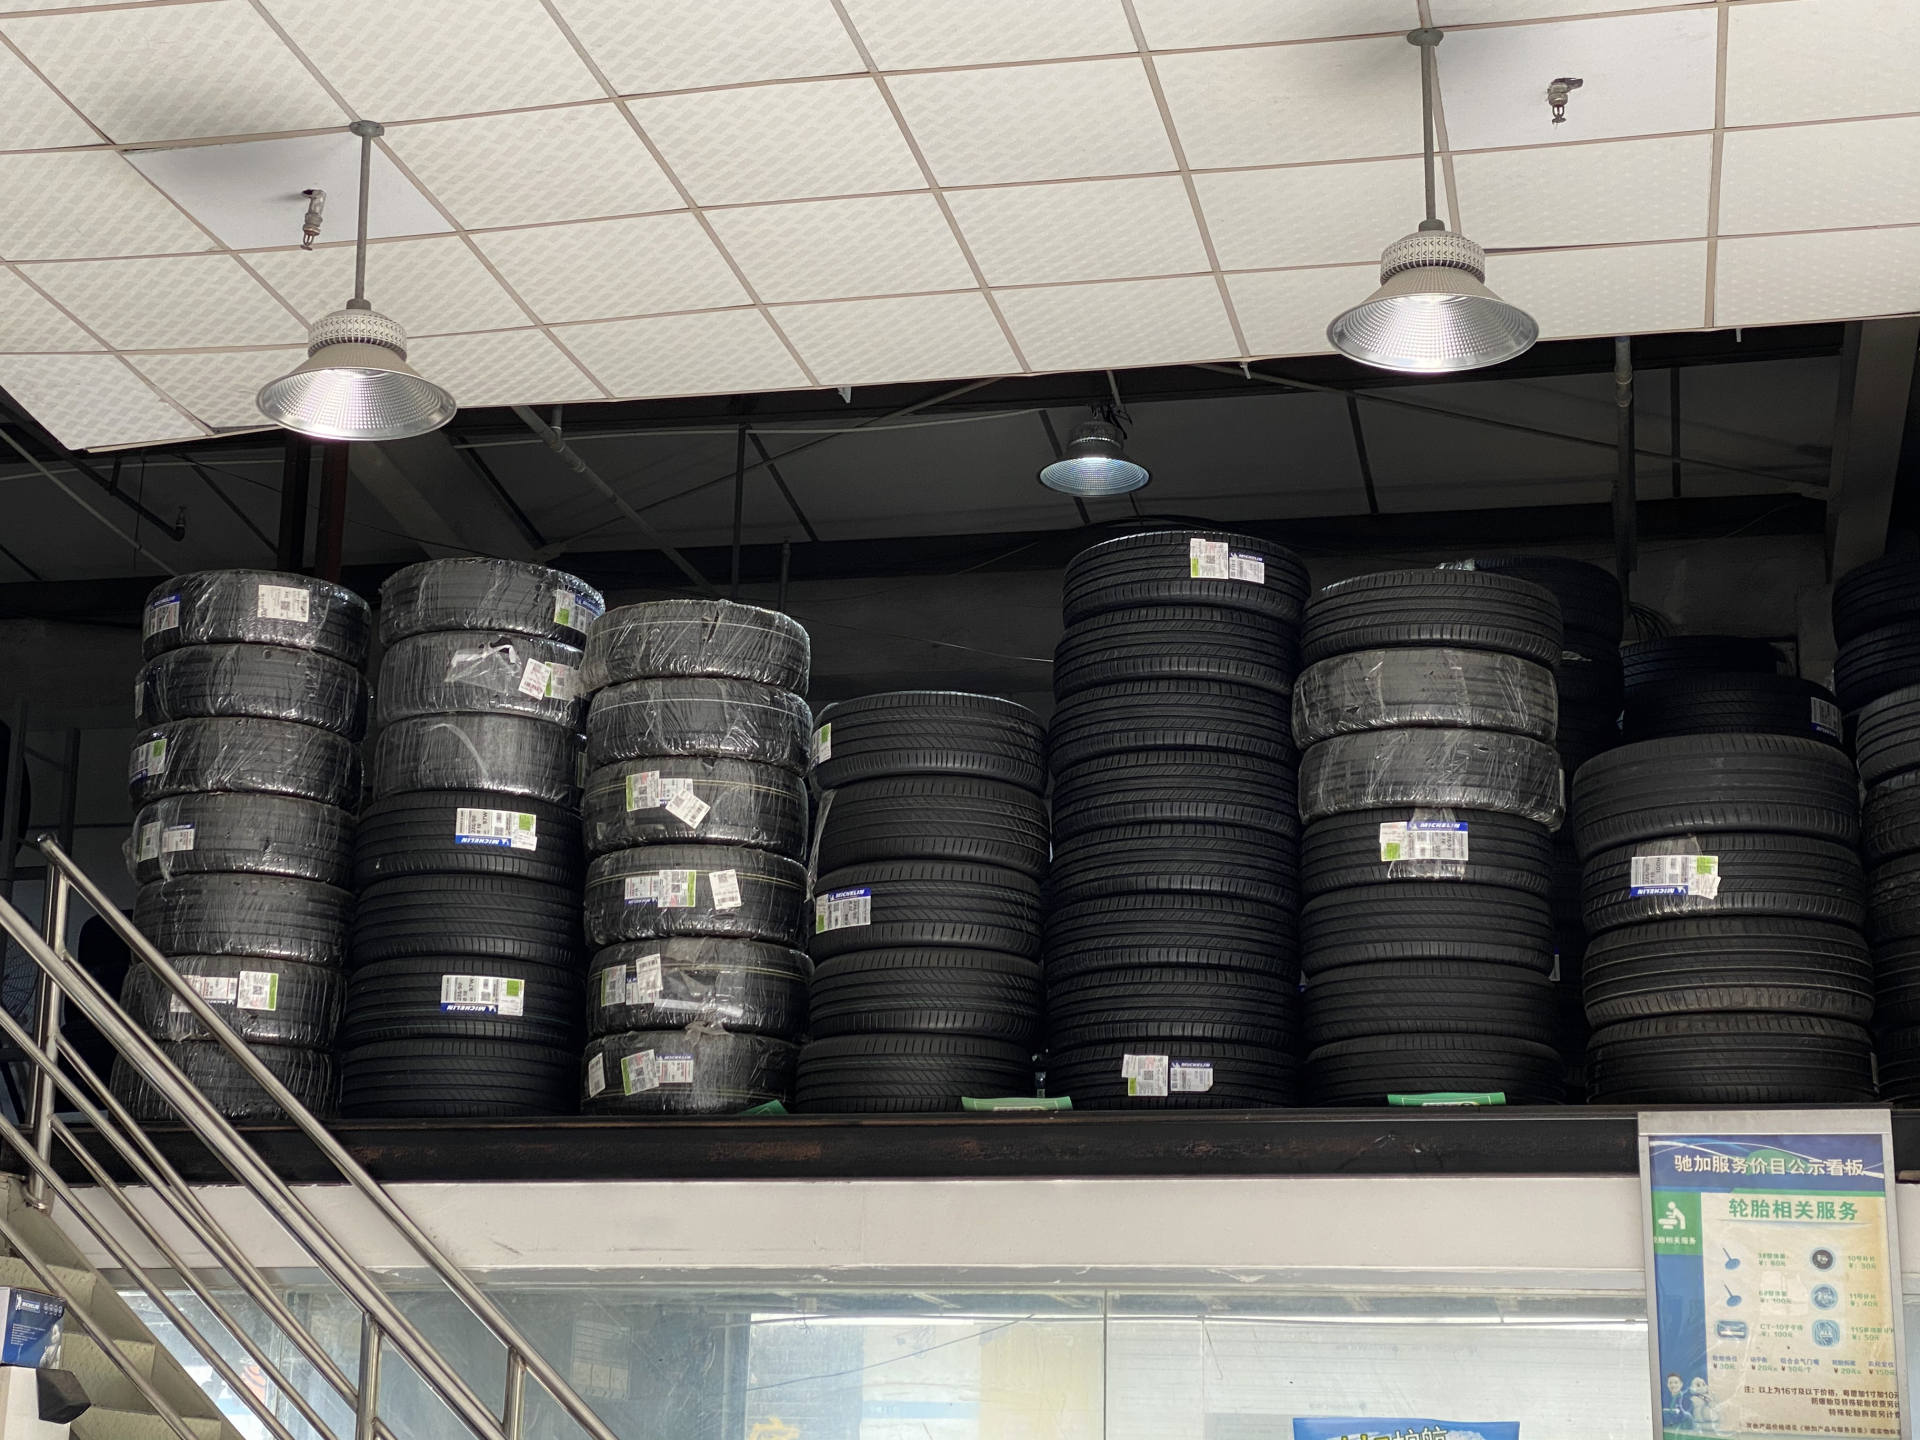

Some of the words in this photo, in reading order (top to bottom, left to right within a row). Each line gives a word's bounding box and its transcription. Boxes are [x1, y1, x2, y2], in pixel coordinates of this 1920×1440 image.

[461, 837, 500, 845] MICHELIN
[1674, 1155, 1864, 1176] 驰加服务价目公示看板
[1728, 1198, 1858, 1220] 轮胎相关服务
